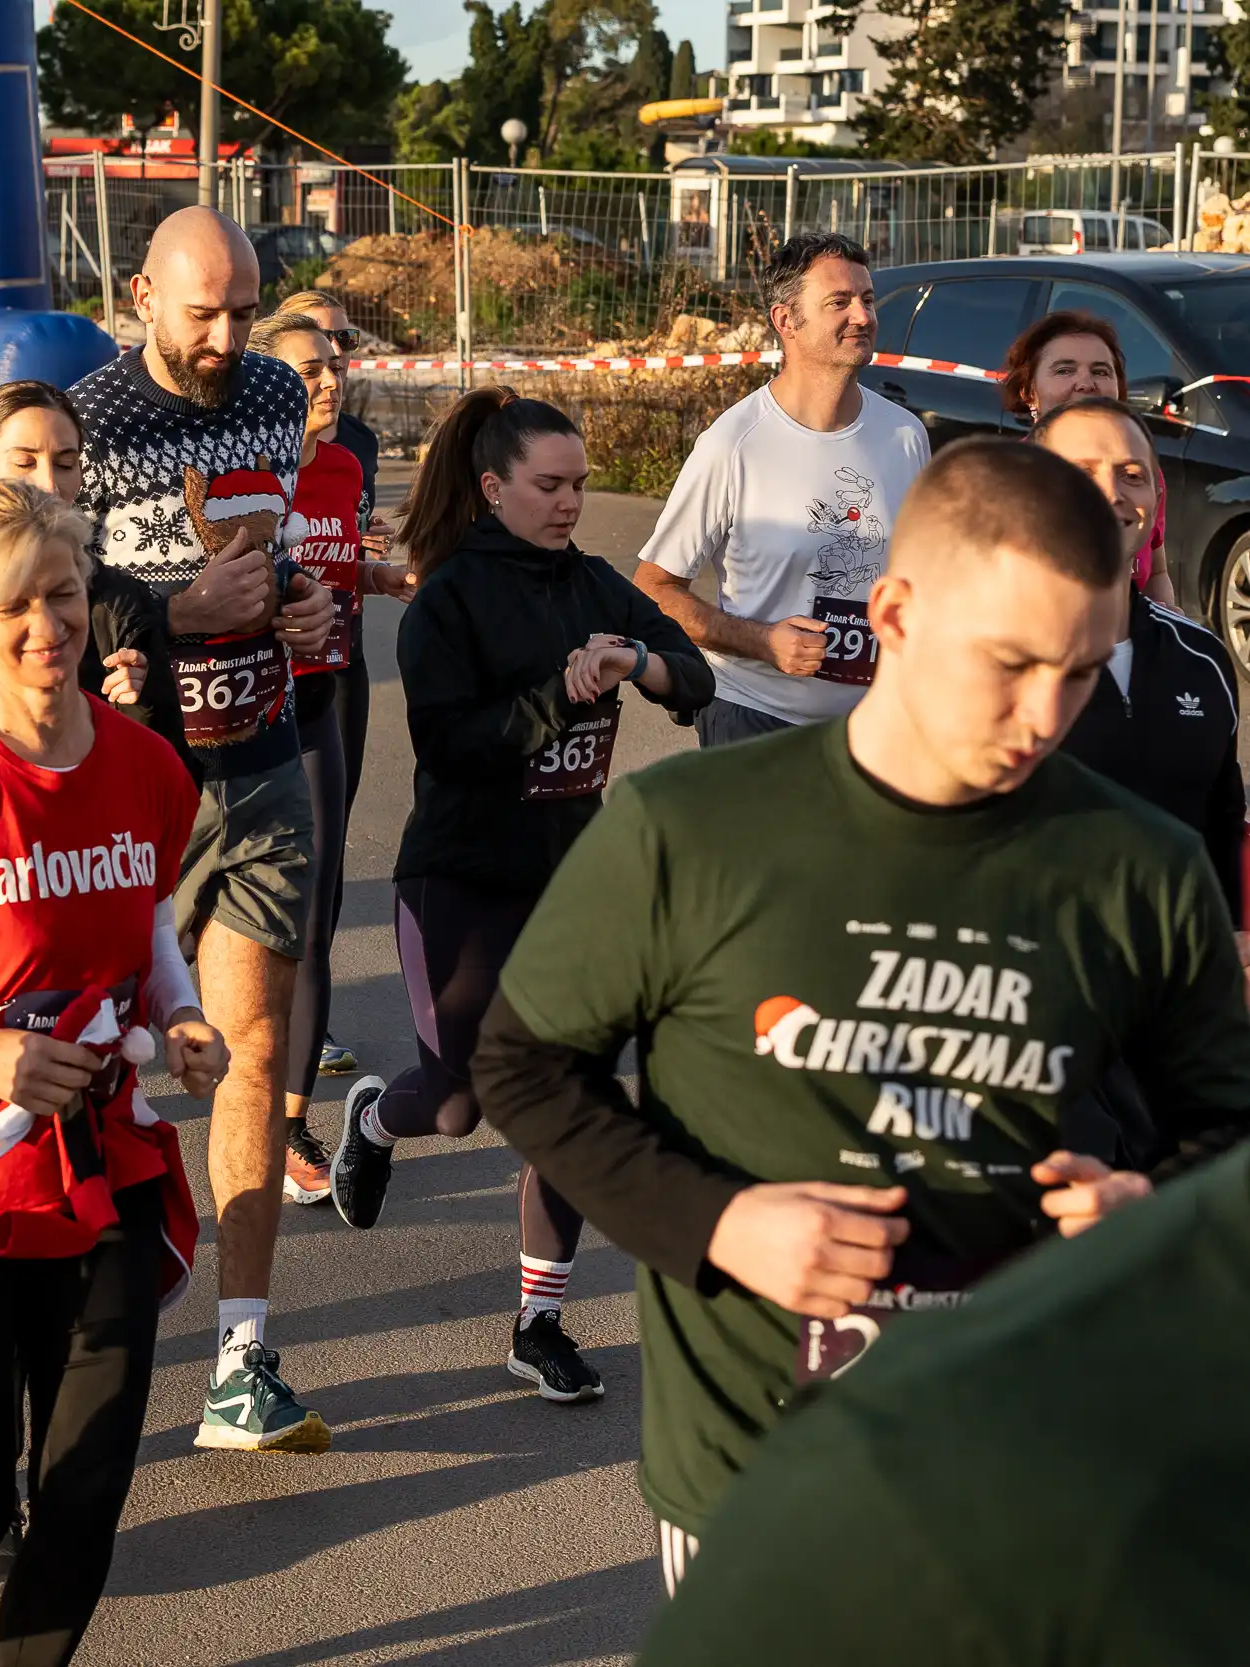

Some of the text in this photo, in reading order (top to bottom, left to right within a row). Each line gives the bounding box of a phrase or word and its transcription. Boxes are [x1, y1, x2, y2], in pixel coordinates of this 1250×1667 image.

[306, 518, 343, 537] DAR
[825, 612, 848, 624] ZADAR
[178, 661, 208, 673] ZADAR
[207, 654, 256, 671] CHRISTMAS
[257, 649, 274, 662] RUN
[825, 627, 878, 662] 291
[179, 670, 256, 713] 362
[539, 735, 596, 773] 363
[856, 950, 1032, 1025] ZADAR
[770, 1005, 1074, 1095] CHRISTMAS
[866, 1081, 983, 1141] RUN
